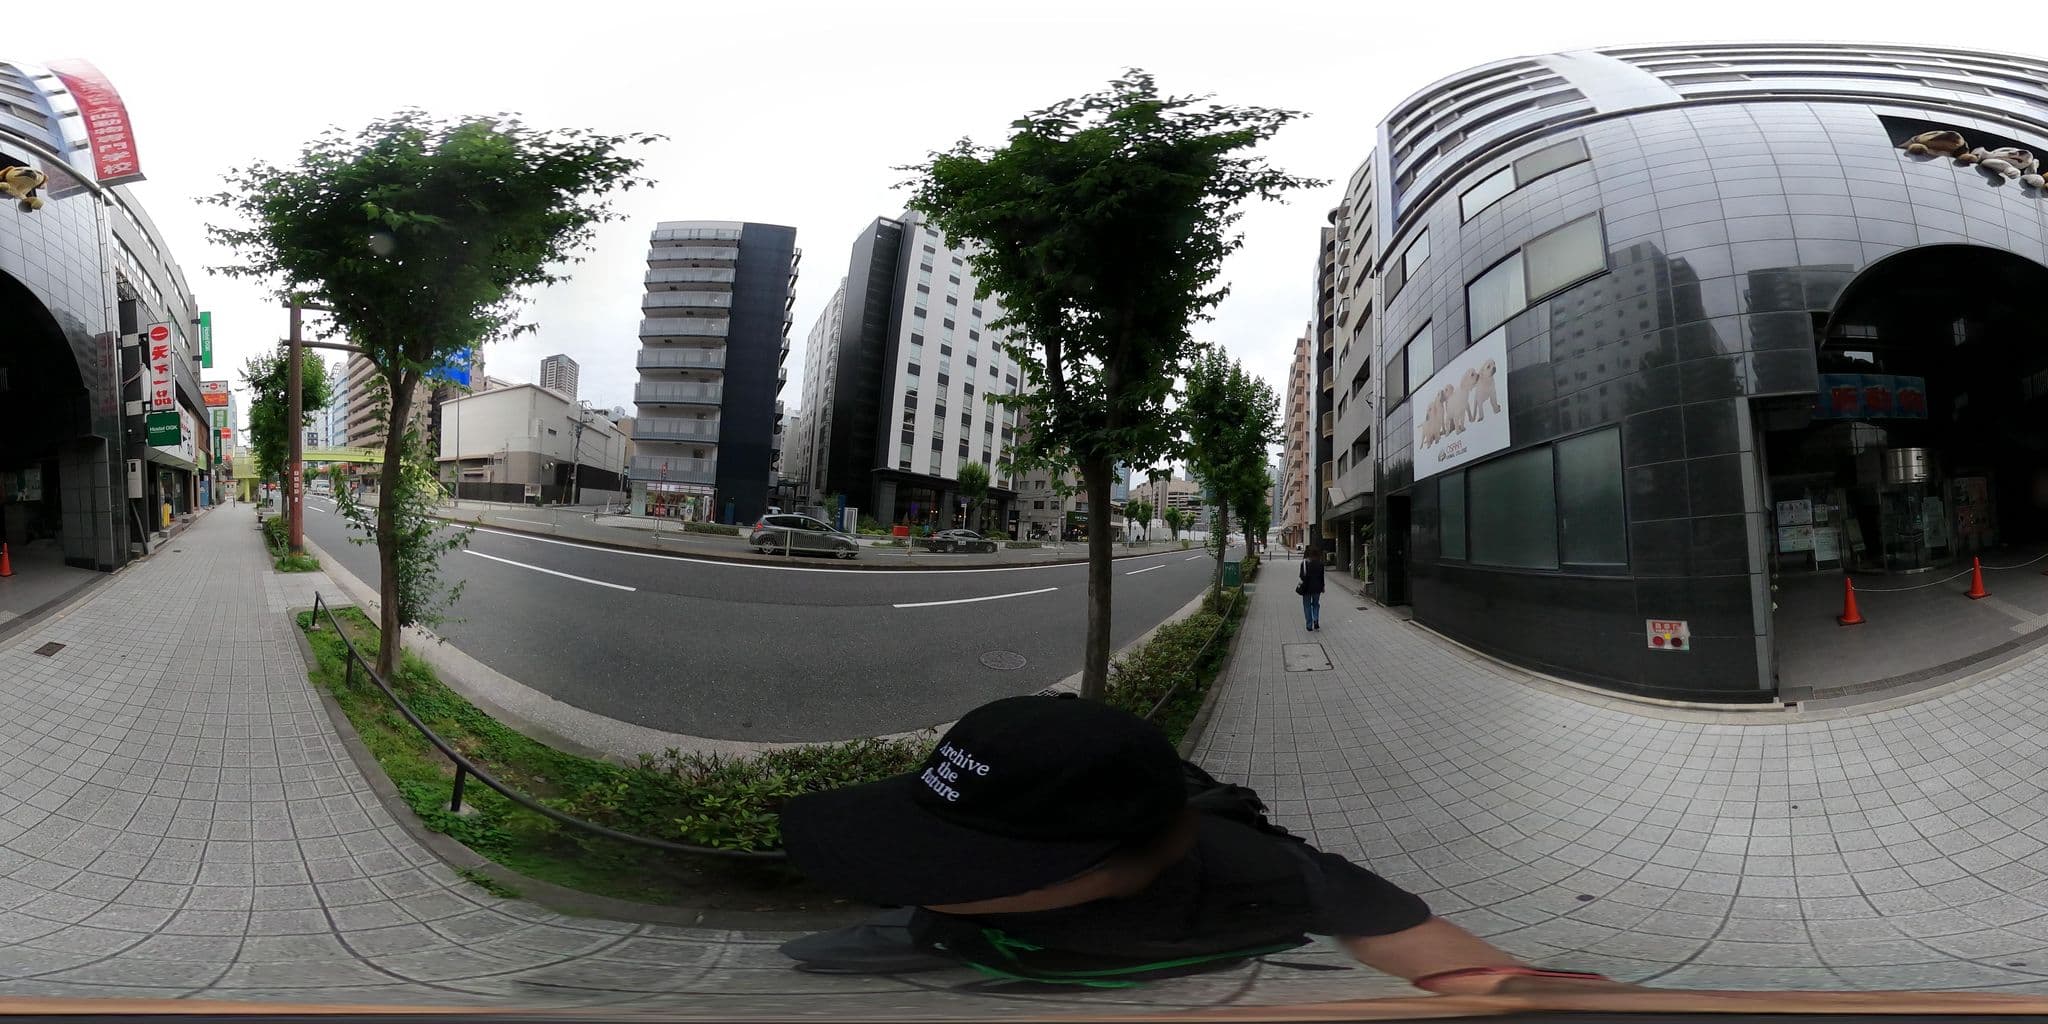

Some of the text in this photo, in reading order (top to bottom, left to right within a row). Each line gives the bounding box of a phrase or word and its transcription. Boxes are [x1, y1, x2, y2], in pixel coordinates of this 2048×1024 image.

[152, 344, 172, 406] 天下一品
[937, 761, 958, 783] the
[939, 741, 990, 776] Archive
[921, 767, 960, 802] future
